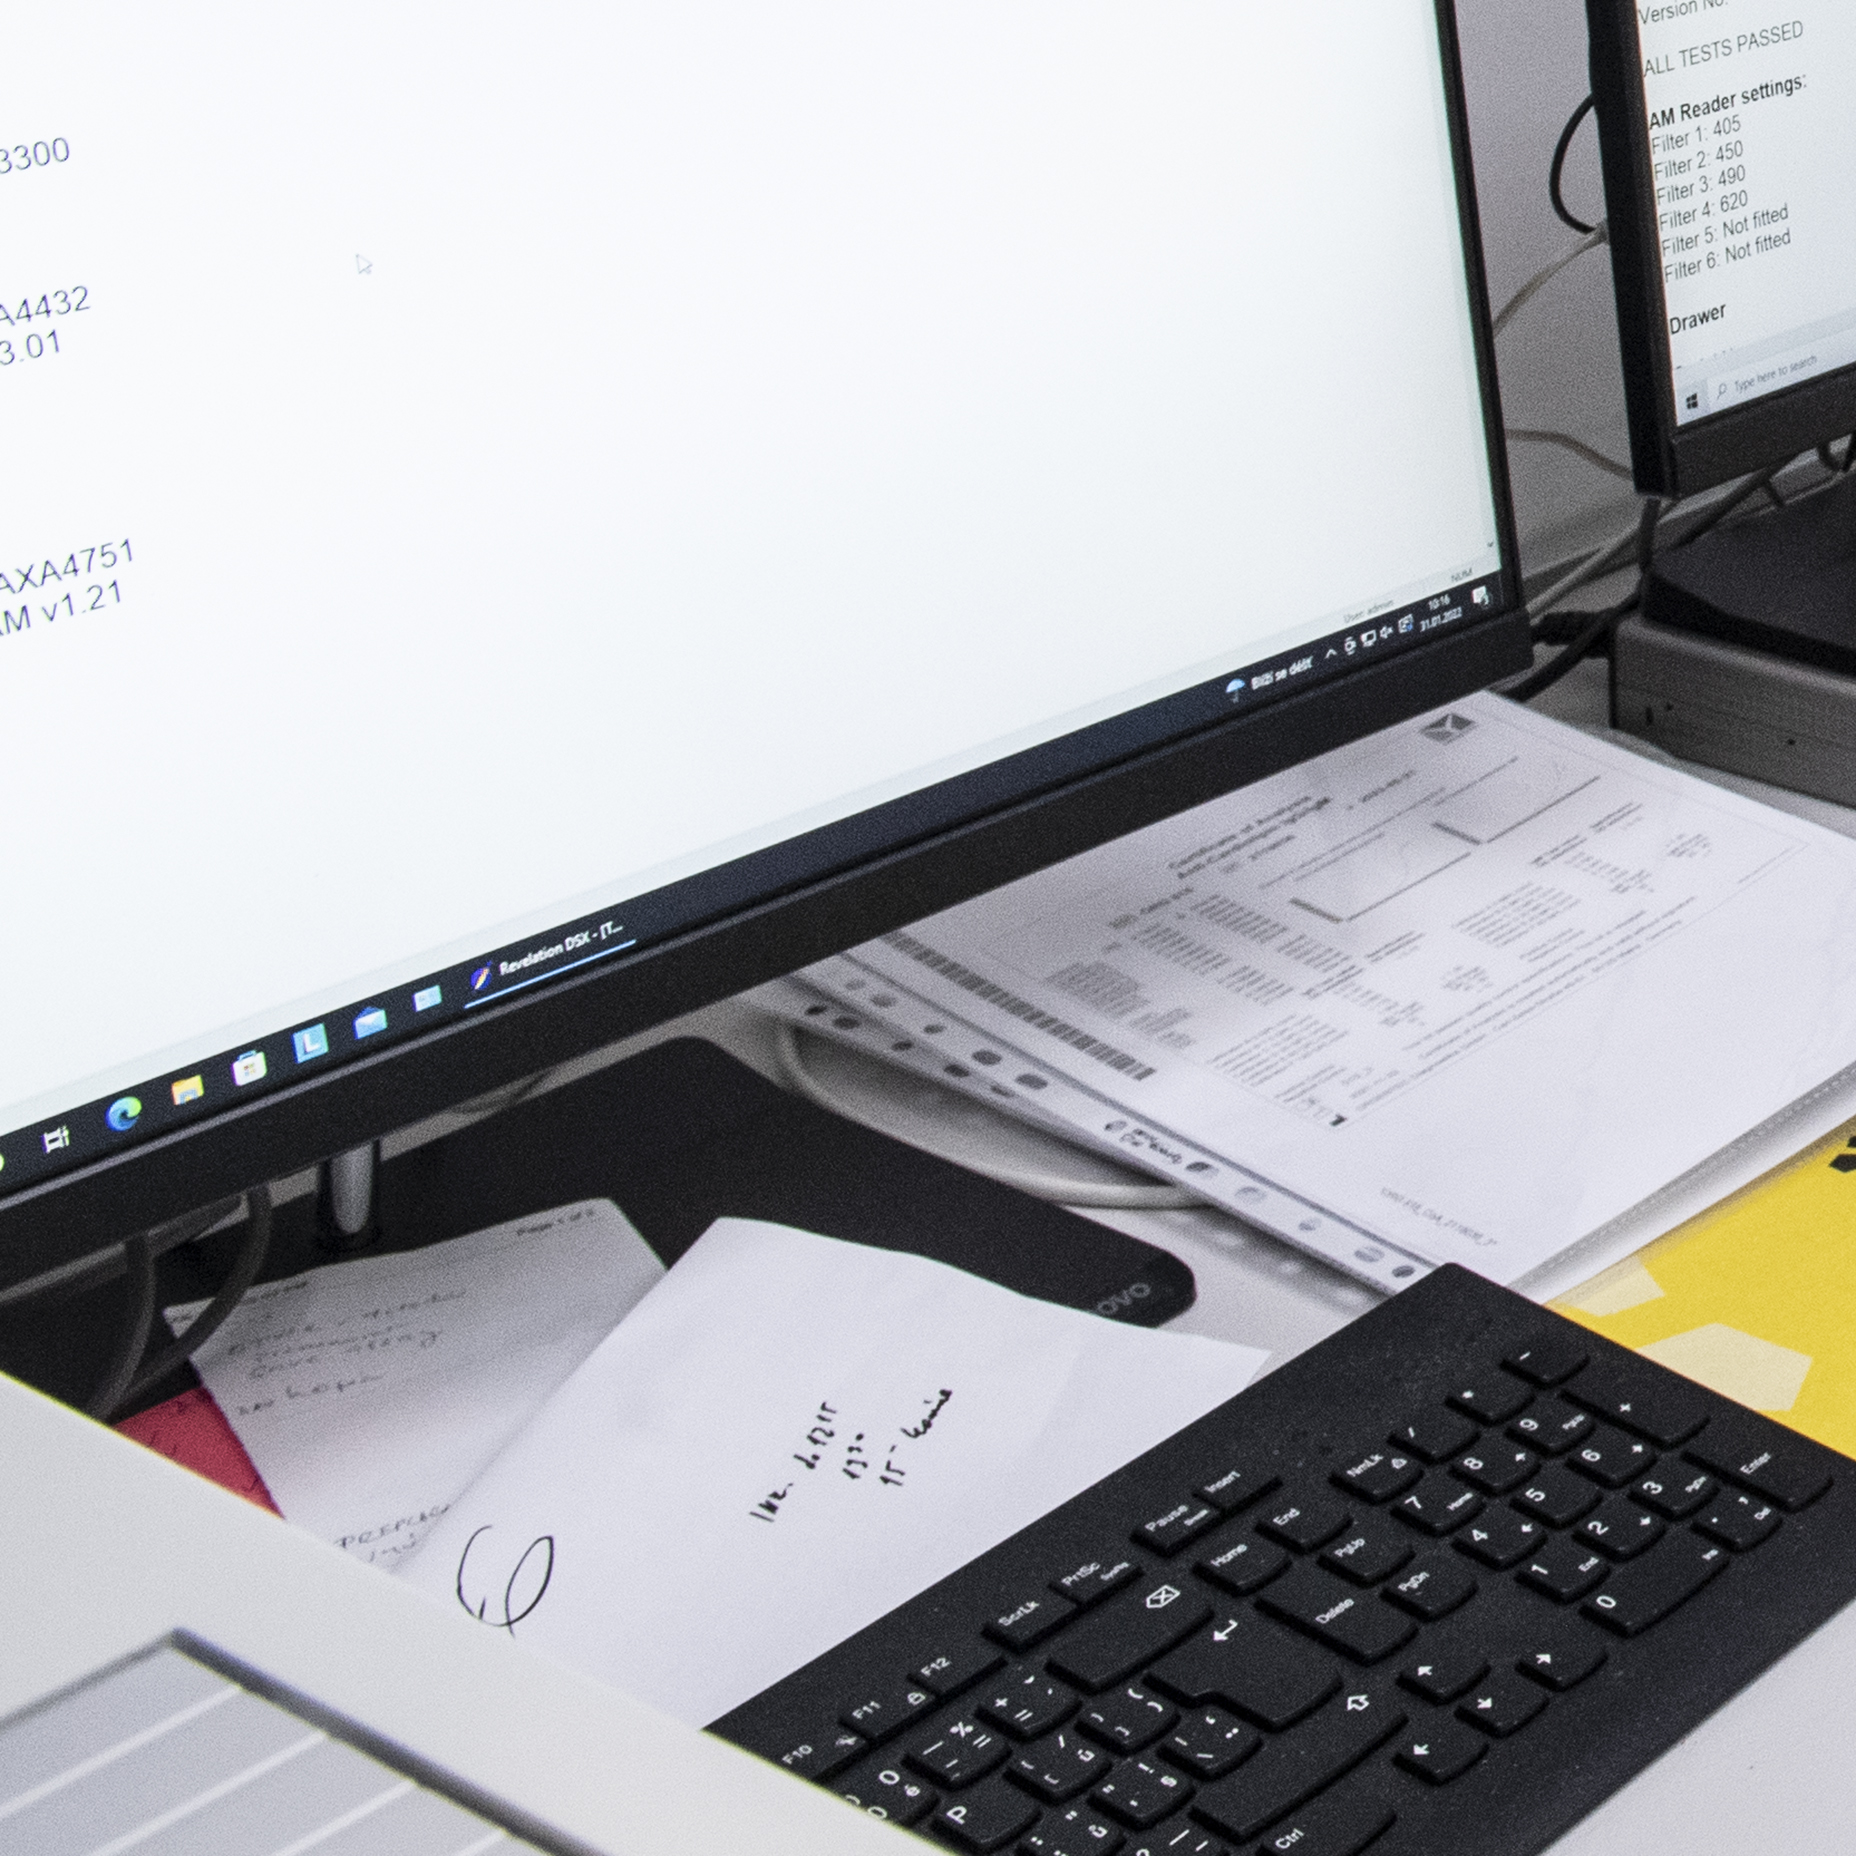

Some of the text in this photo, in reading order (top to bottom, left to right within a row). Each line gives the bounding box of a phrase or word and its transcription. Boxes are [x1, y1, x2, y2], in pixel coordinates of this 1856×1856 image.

[1638, 0, 1698, 25] Version
[1644, 20, 1804, 78] ALL TESTS PASSED
[1649, 74, 1807, 130] AM Reader settings:
[1651, 114, 1741, 155] Filter 1: 405
[1653, 140, 1743, 181] Filter 2: 450
[1656, 164, 1746, 206] Filter 3: 490
[1659, 189, 1748, 232] Filter 4: 620
[1662, 202, 1789, 257] Filter 5: Not fitted
[1664, 228, 1791, 283] Filter 6: Not fitted
[1669, 304, 1726, 335] Drawer
[41, 579, 121, 622] v1.21
[499, 944, 564, 976] Revelation
[564, 931, 591, 951] DSX
[1519, 1418, 1539, 1431] 9
[1463, 1457, 1484, 1470] 8
[1580, 1448, 1601, 1463] 6
[1740, 1451, 1772, 1475] Enter
[1204, 1470, 1241, 1494] Insert
[1642, 1480, 1663, 1495] 3
[1404, 1496, 1422, 1510] 7
[1525, 1488, 1546, 1502] 5
[1145, 1504, 1188, 1532] Pause
[1273, 1507, 1300, 1526] End
[1587, 1521, 1609, 1536] 2
[1471, 1528, 1488, 1542] 4
[1210, 1544, 1248, 1568] Home
[1062, 1562, 1100, 1586] PrtSc
[1531, 1564, 1548, 1576] 1
[998, 1600, 1040, 1626] ScrLk
[1315, 1598, 1354, 1624] Delete
[921, 1656, 950, 1677] F12
[852, 1700, 881, 1720] F11
[782, 1744, 812, 1765] F10
[946, 1806, 967, 1824] P
[1274, 1828, 1304, 1849] Ctrl
